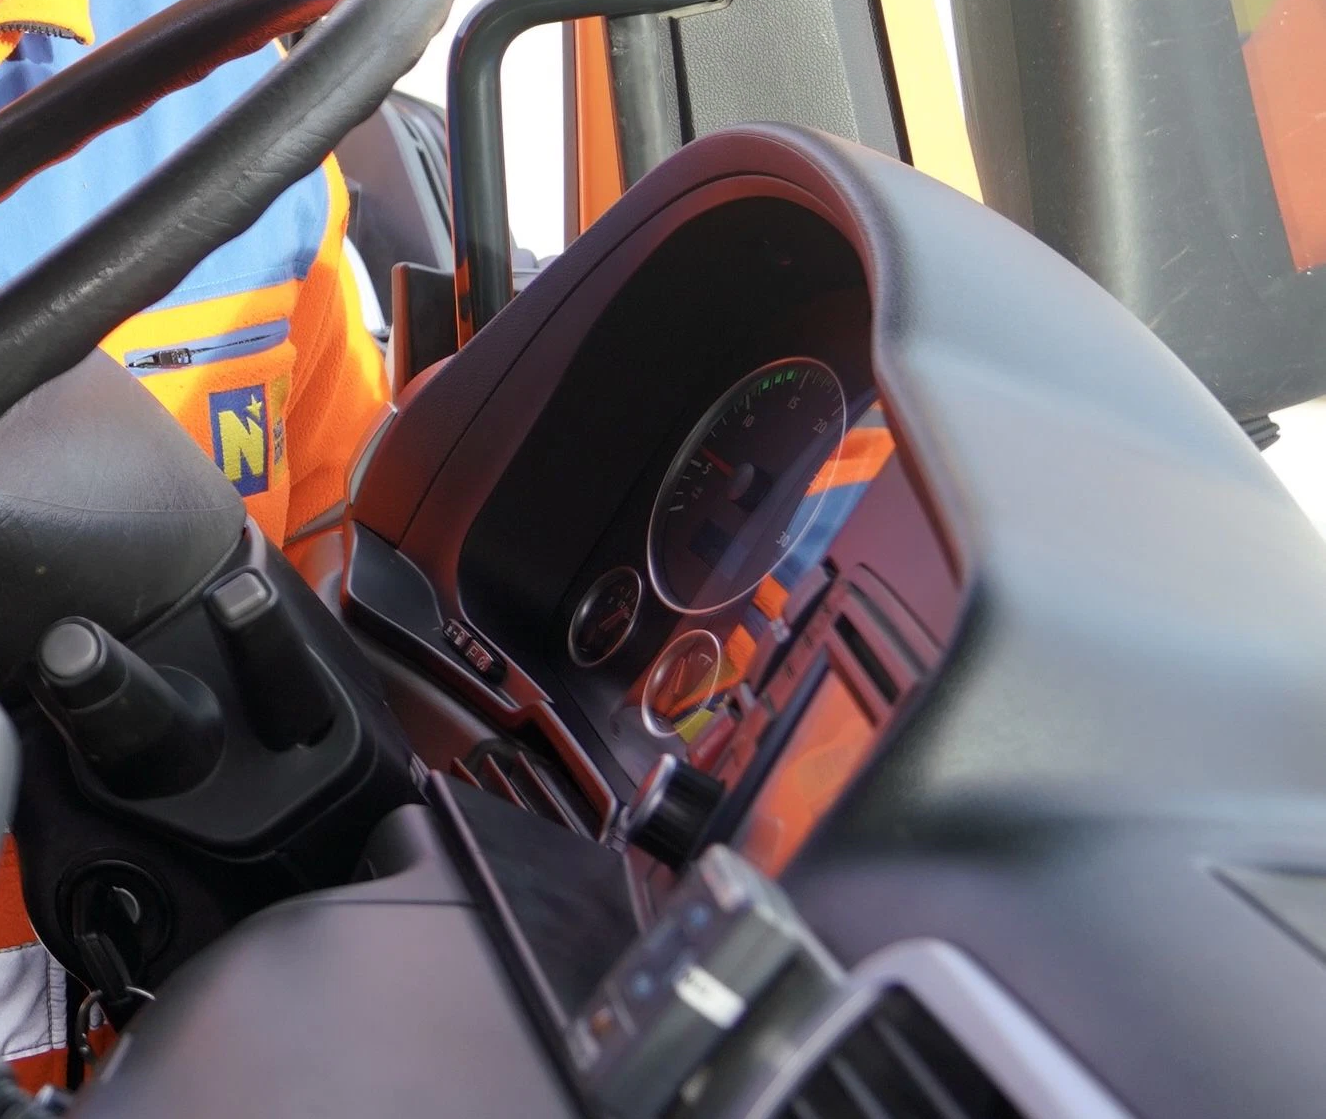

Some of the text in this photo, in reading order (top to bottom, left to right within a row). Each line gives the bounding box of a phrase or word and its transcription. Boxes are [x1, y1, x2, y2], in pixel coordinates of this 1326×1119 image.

[812, 418, 828, 434] 20
[217, 409, 265, 482] N
[775, 530, 791, 548] 30
